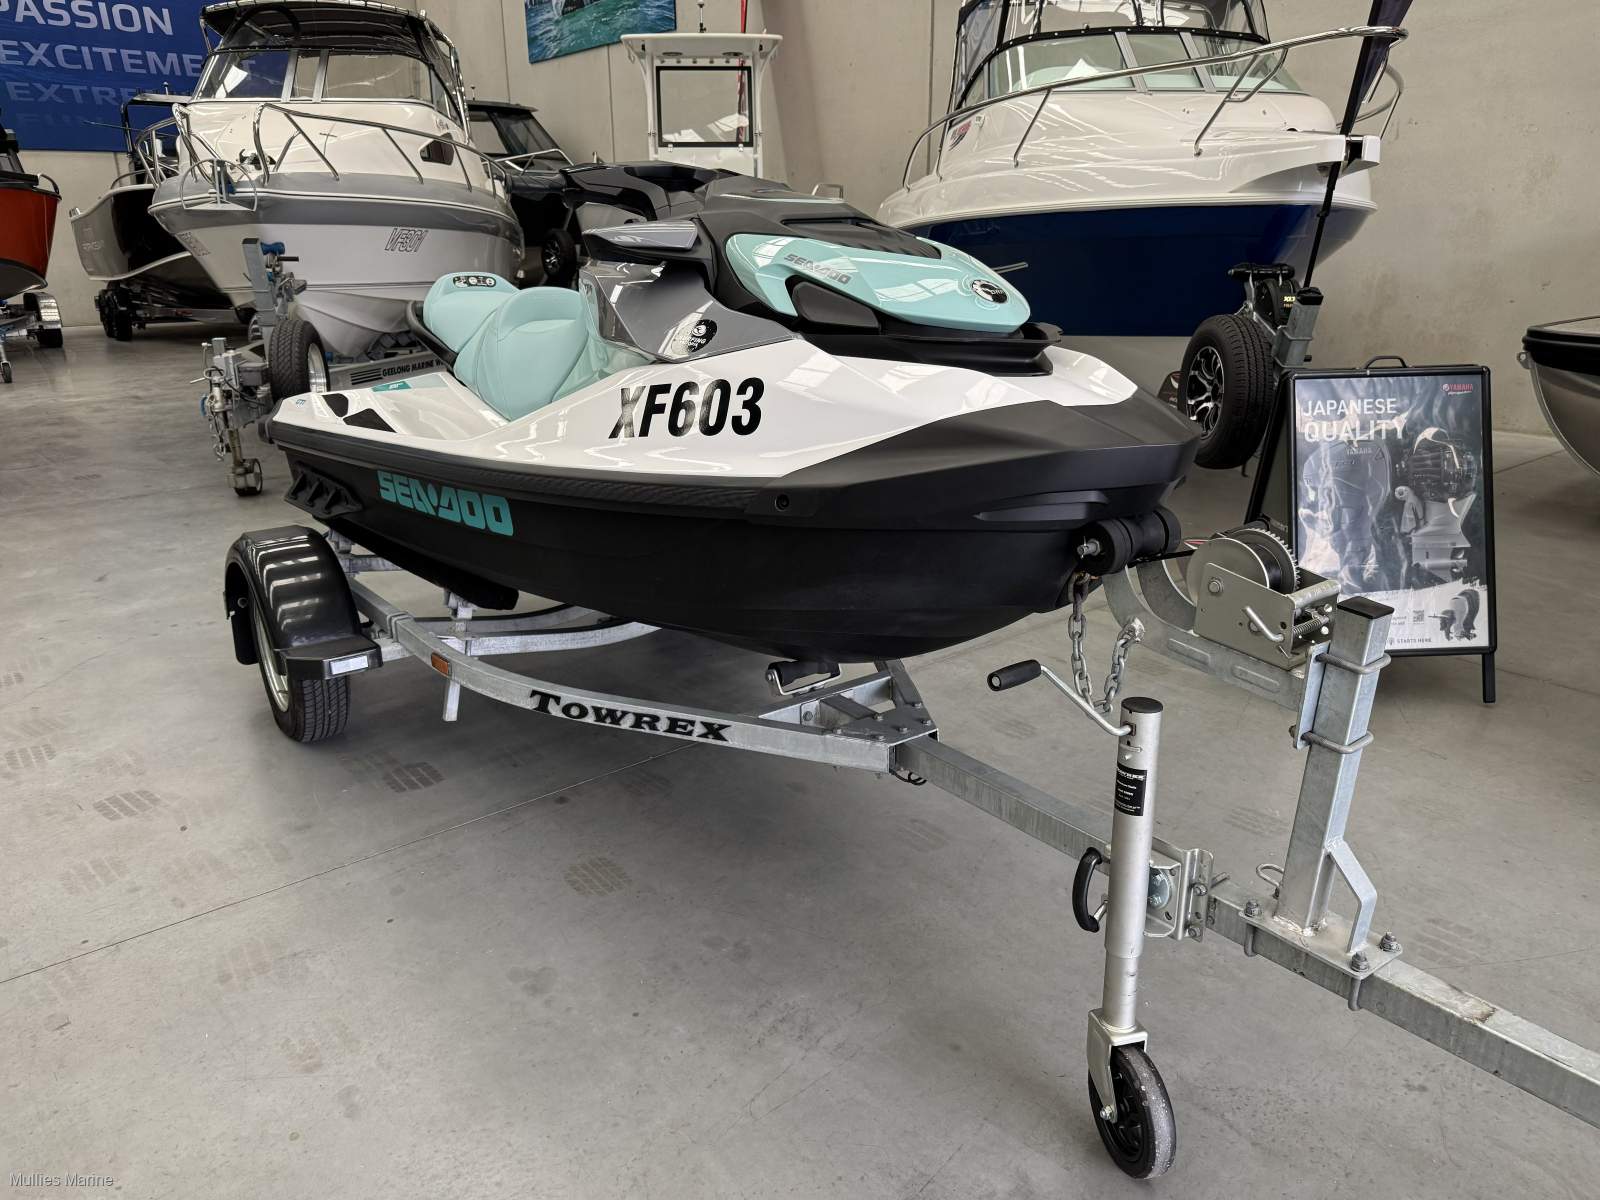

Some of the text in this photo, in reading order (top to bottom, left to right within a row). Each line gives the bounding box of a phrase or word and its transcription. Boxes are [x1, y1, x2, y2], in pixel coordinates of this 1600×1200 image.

[382, 366, 411, 377] GEELONG
[411, 360, 434, 372] MARINE
[1450, 383, 1473, 392] YAMAHA
[608, 377, 765, 438] XF603
[1303, 398, 1398, 416] JAPANESE
[1304, 419, 1408, 443] QUALITY
